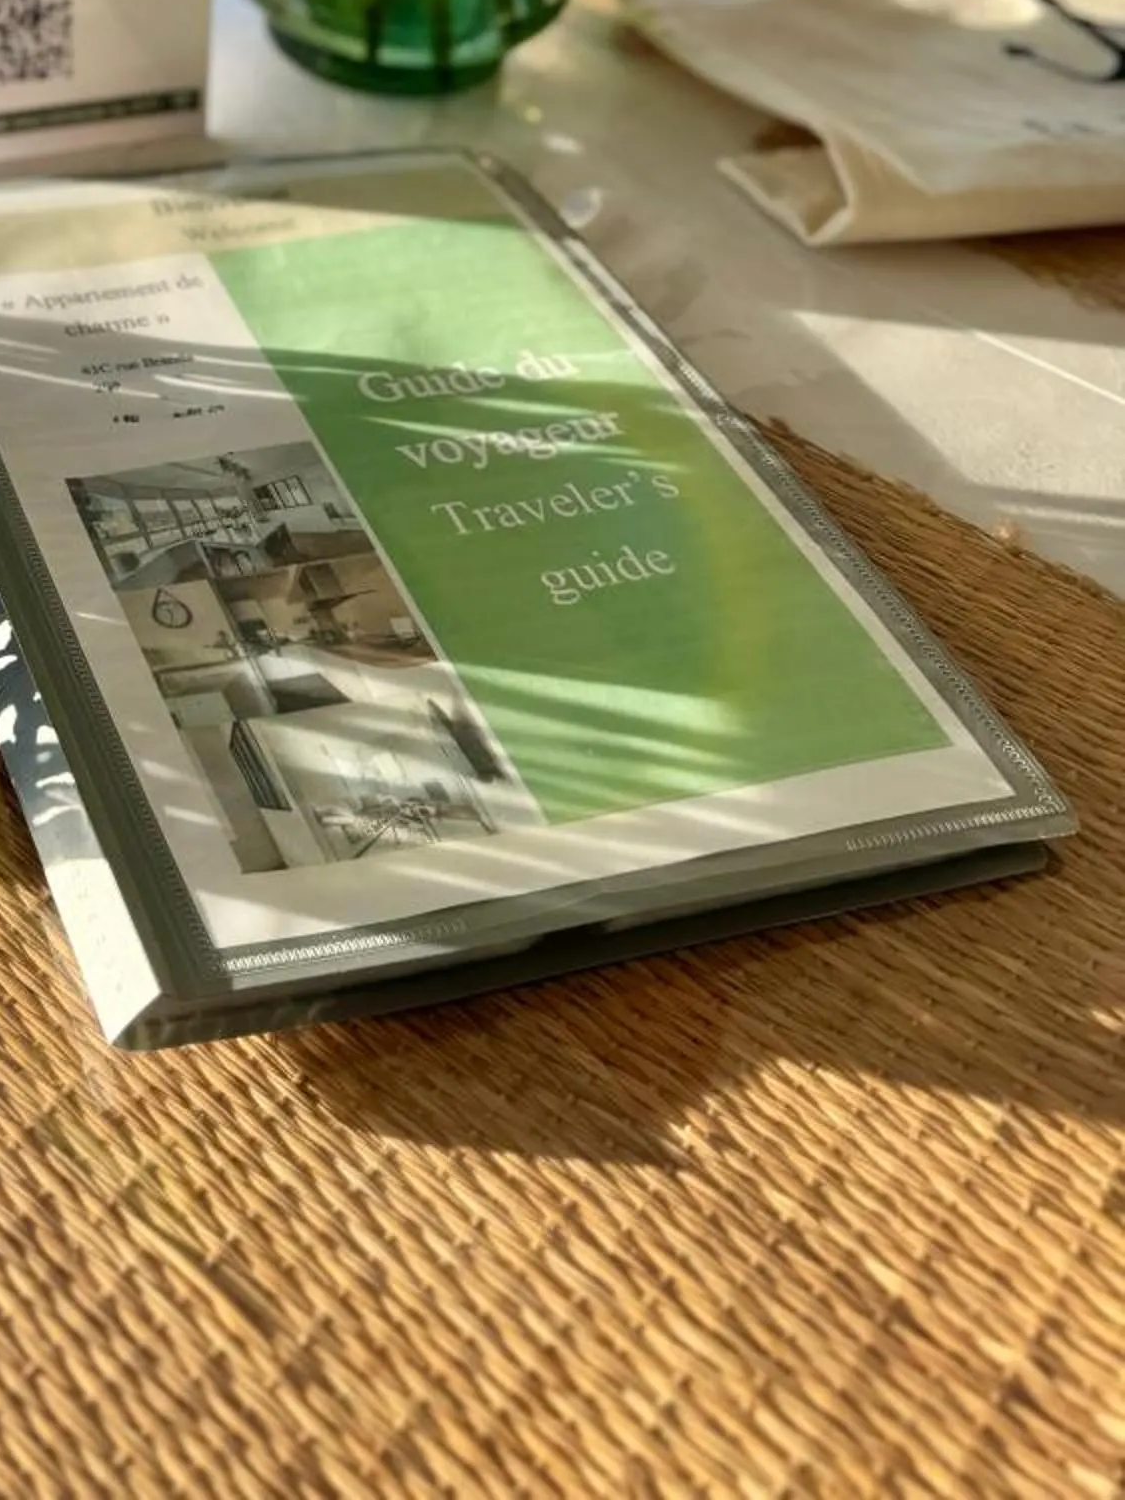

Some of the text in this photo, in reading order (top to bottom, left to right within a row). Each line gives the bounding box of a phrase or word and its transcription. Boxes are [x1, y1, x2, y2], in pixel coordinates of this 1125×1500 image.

[176, 273, 204, 292] de
[357, 348, 579, 402] Guide du
[395, 411, 625, 469] voyageur
[540, 545, 676, 605] guide
